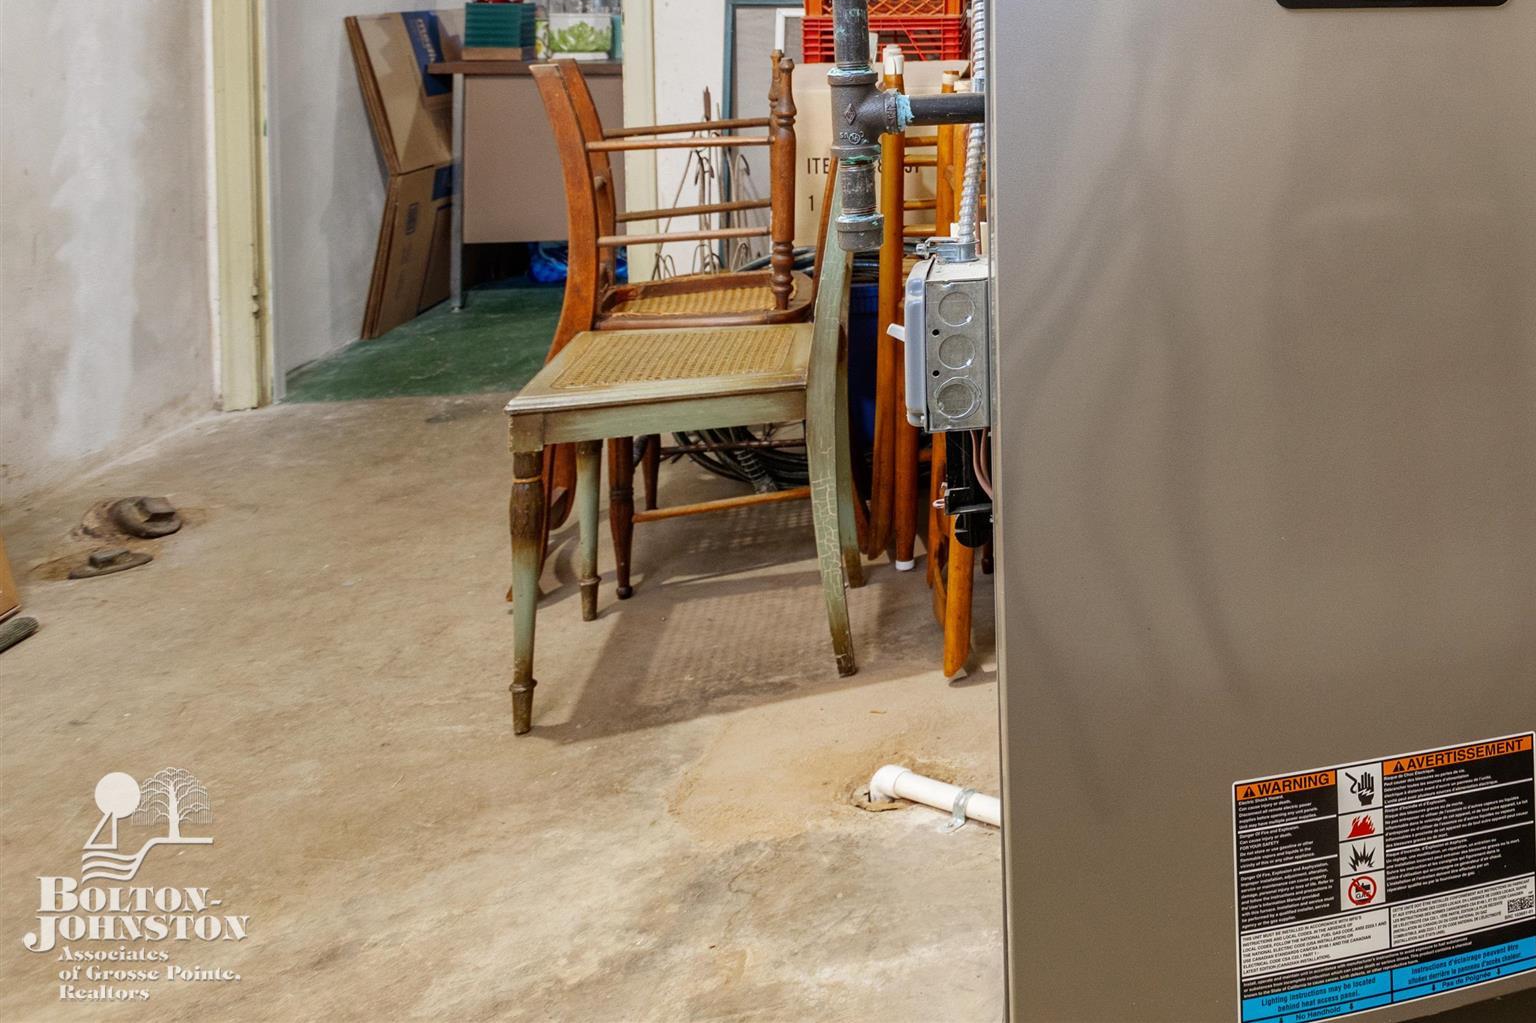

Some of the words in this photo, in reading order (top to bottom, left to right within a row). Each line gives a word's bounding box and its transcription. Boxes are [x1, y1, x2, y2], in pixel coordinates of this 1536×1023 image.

[808, 158, 830, 174] ITE
[810, 195, 814, 211] 1
[1407, 739, 1524, 770] AVERTISSEMENT
[1258, 773, 1329, 796] WARNING
[1261, 994, 1288, 1006] Lighting
[1289, 988, 1327, 1001] instructions
[1328, 986, 1342, 996] may
[1353, 977, 1376, 988] located
[1442, 980, 1454, 988] Pas
[1278, 1002, 1300, 1012] behind
[1301, 999, 1316, 1008] heat
[1296, 1013, 1306, 1021] No
[1308, 1006, 1341, 1018] Handhold
